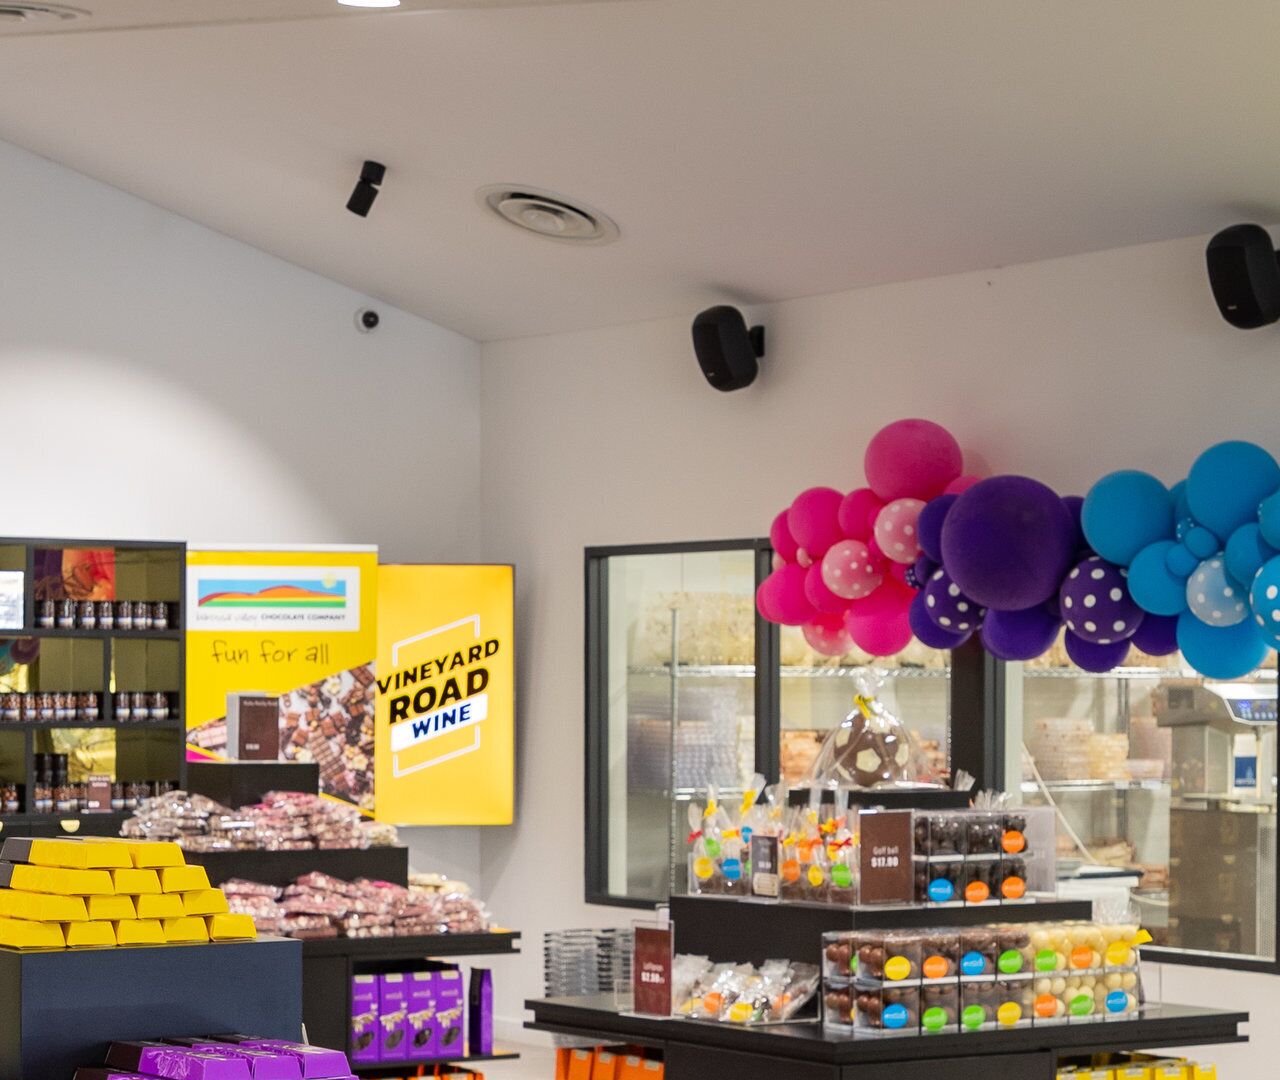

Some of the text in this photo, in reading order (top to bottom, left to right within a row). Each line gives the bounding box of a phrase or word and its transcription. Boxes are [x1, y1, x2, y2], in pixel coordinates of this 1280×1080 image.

[212, 640, 329, 664] fun for all
[376, 639, 500, 695] VINEYARD
[389, 668, 489, 724] ROAD
[412, 703, 471, 738] WINE
